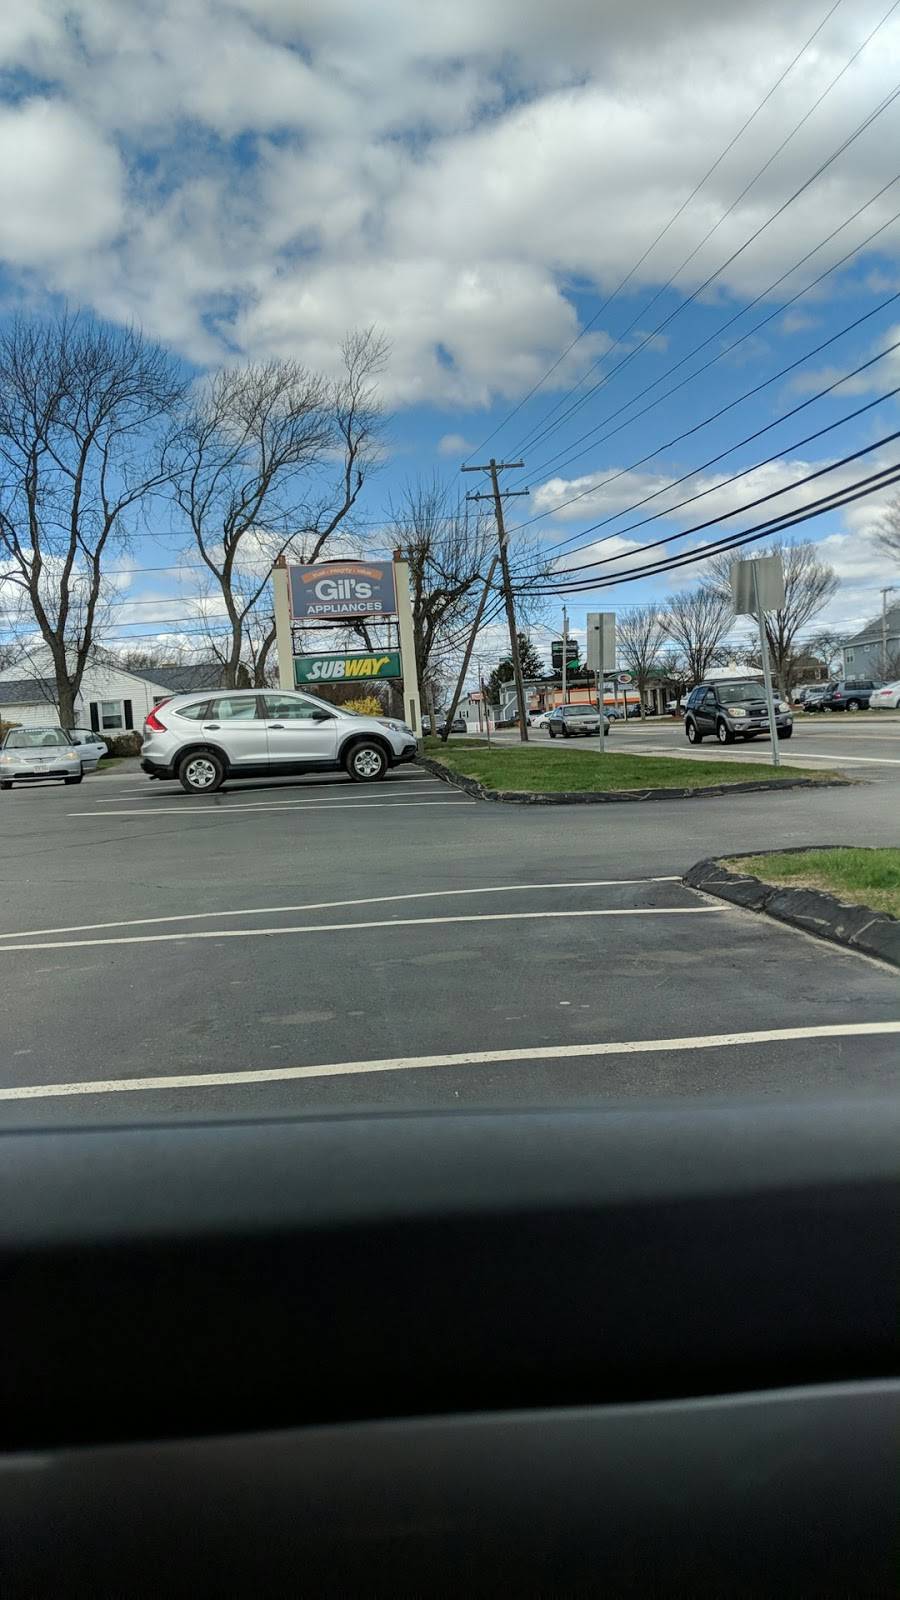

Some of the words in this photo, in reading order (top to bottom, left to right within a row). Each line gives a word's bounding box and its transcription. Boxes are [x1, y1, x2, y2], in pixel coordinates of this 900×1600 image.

[315, 579, 372, 601] Gil's
[307, 602, 382, 614] APPLIANCES
[305, 656, 390, 680] SUBWAY
